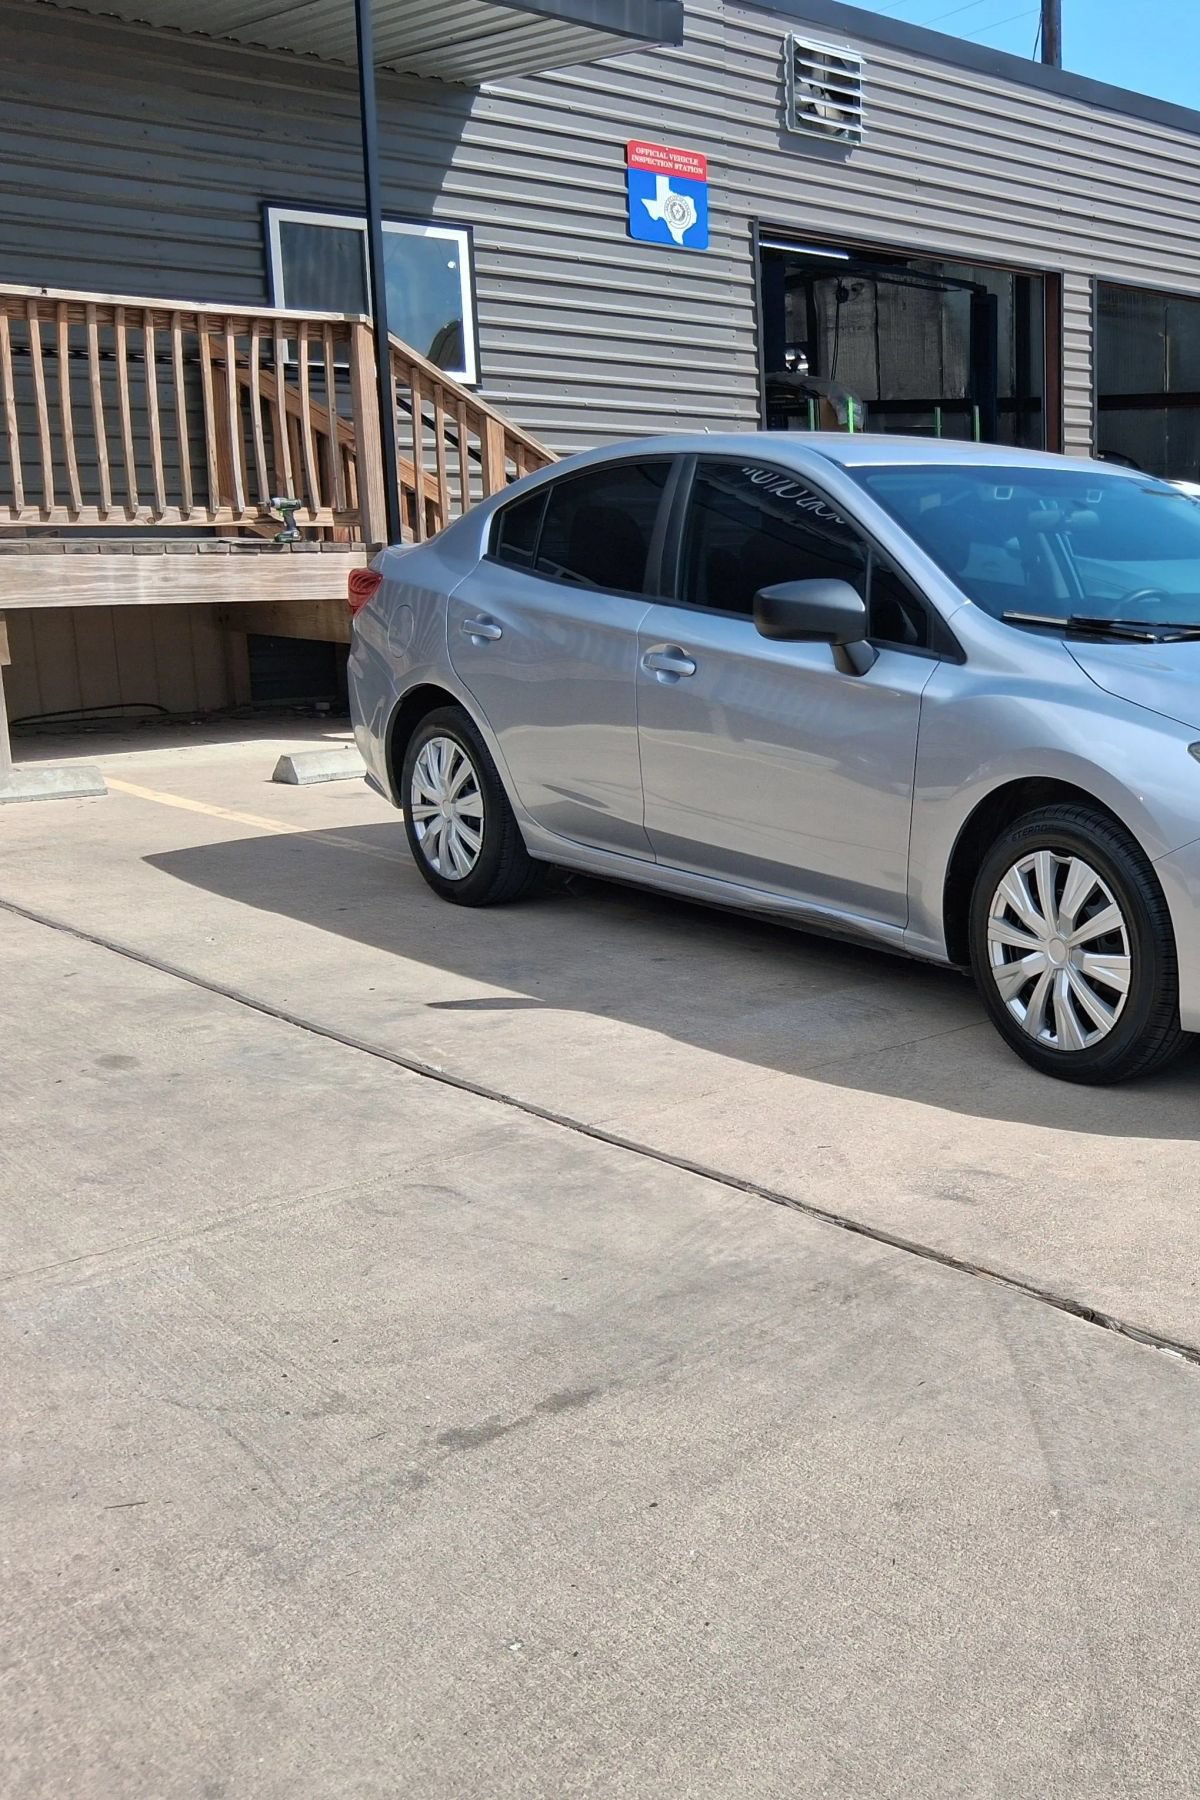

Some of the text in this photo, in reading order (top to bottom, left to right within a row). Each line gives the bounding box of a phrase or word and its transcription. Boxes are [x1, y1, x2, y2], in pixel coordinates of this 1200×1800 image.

[631, 154, 704, 174] INSPECTION STATION
[635, 147, 699, 165] OFFICIAL VEHICLE
